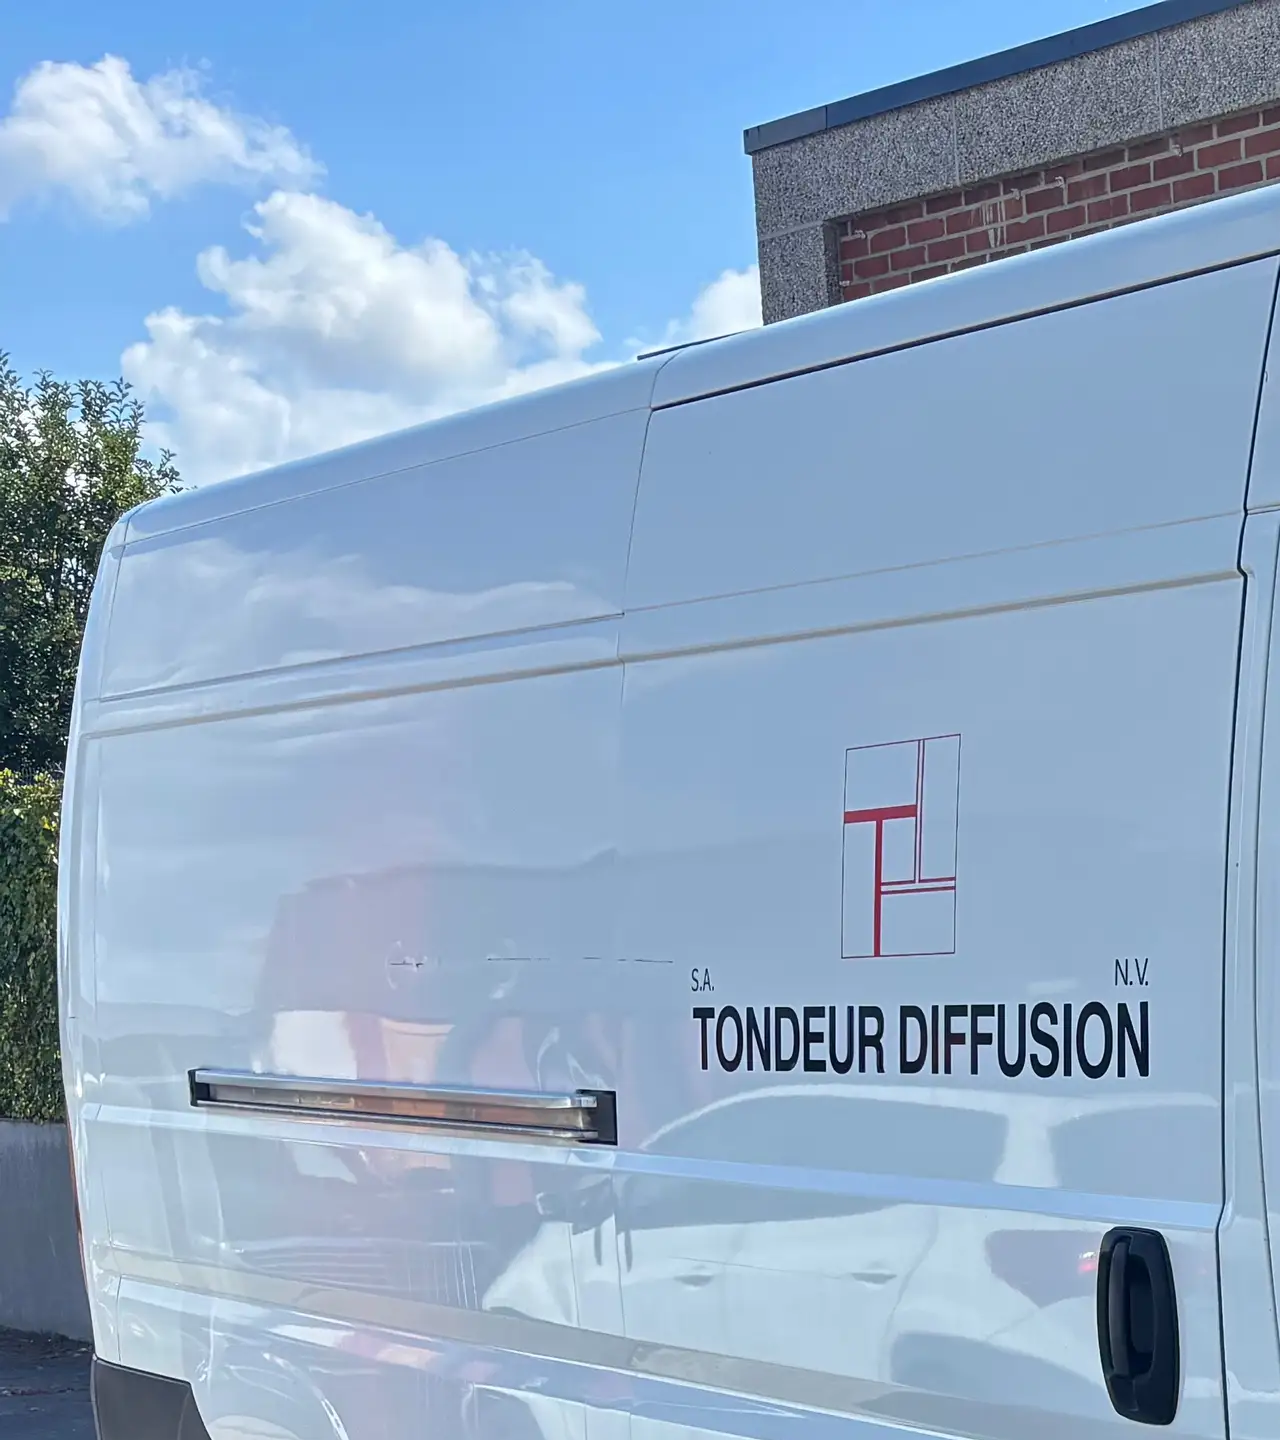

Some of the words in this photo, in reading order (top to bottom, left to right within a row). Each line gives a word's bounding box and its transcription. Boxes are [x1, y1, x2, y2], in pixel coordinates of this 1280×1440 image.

[691, 968, 715, 992] S.A.
[1115, 958, 1149, 987] N.V.
[692, 1005, 885, 1075] TONDEUR
[899, 1000, 1150, 1080] DIFFUSION
